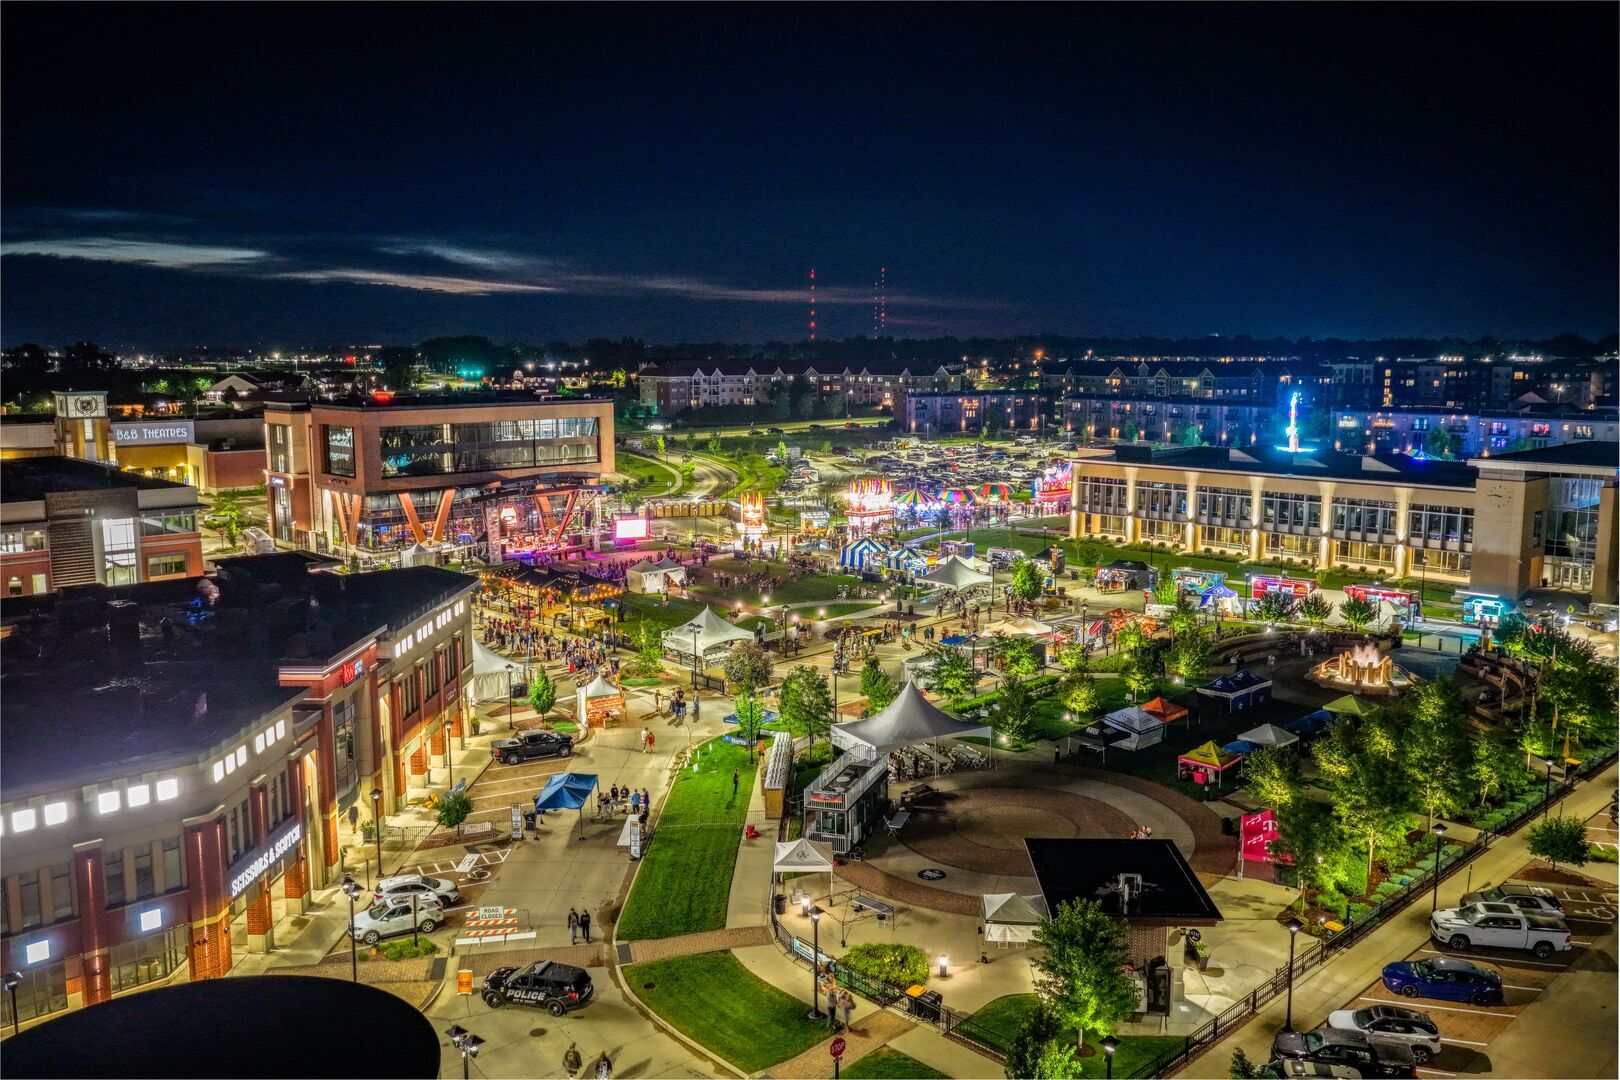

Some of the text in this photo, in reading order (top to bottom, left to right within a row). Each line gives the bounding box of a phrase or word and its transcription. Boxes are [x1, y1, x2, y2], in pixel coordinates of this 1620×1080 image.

[116, 427, 188, 440] B&B THEATRES
[232, 824, 300, 897] SCISSORS & SCOTCH
[506, 989, 546, 1001] POLICE
[831, 1041, 845, 1054] STOP
